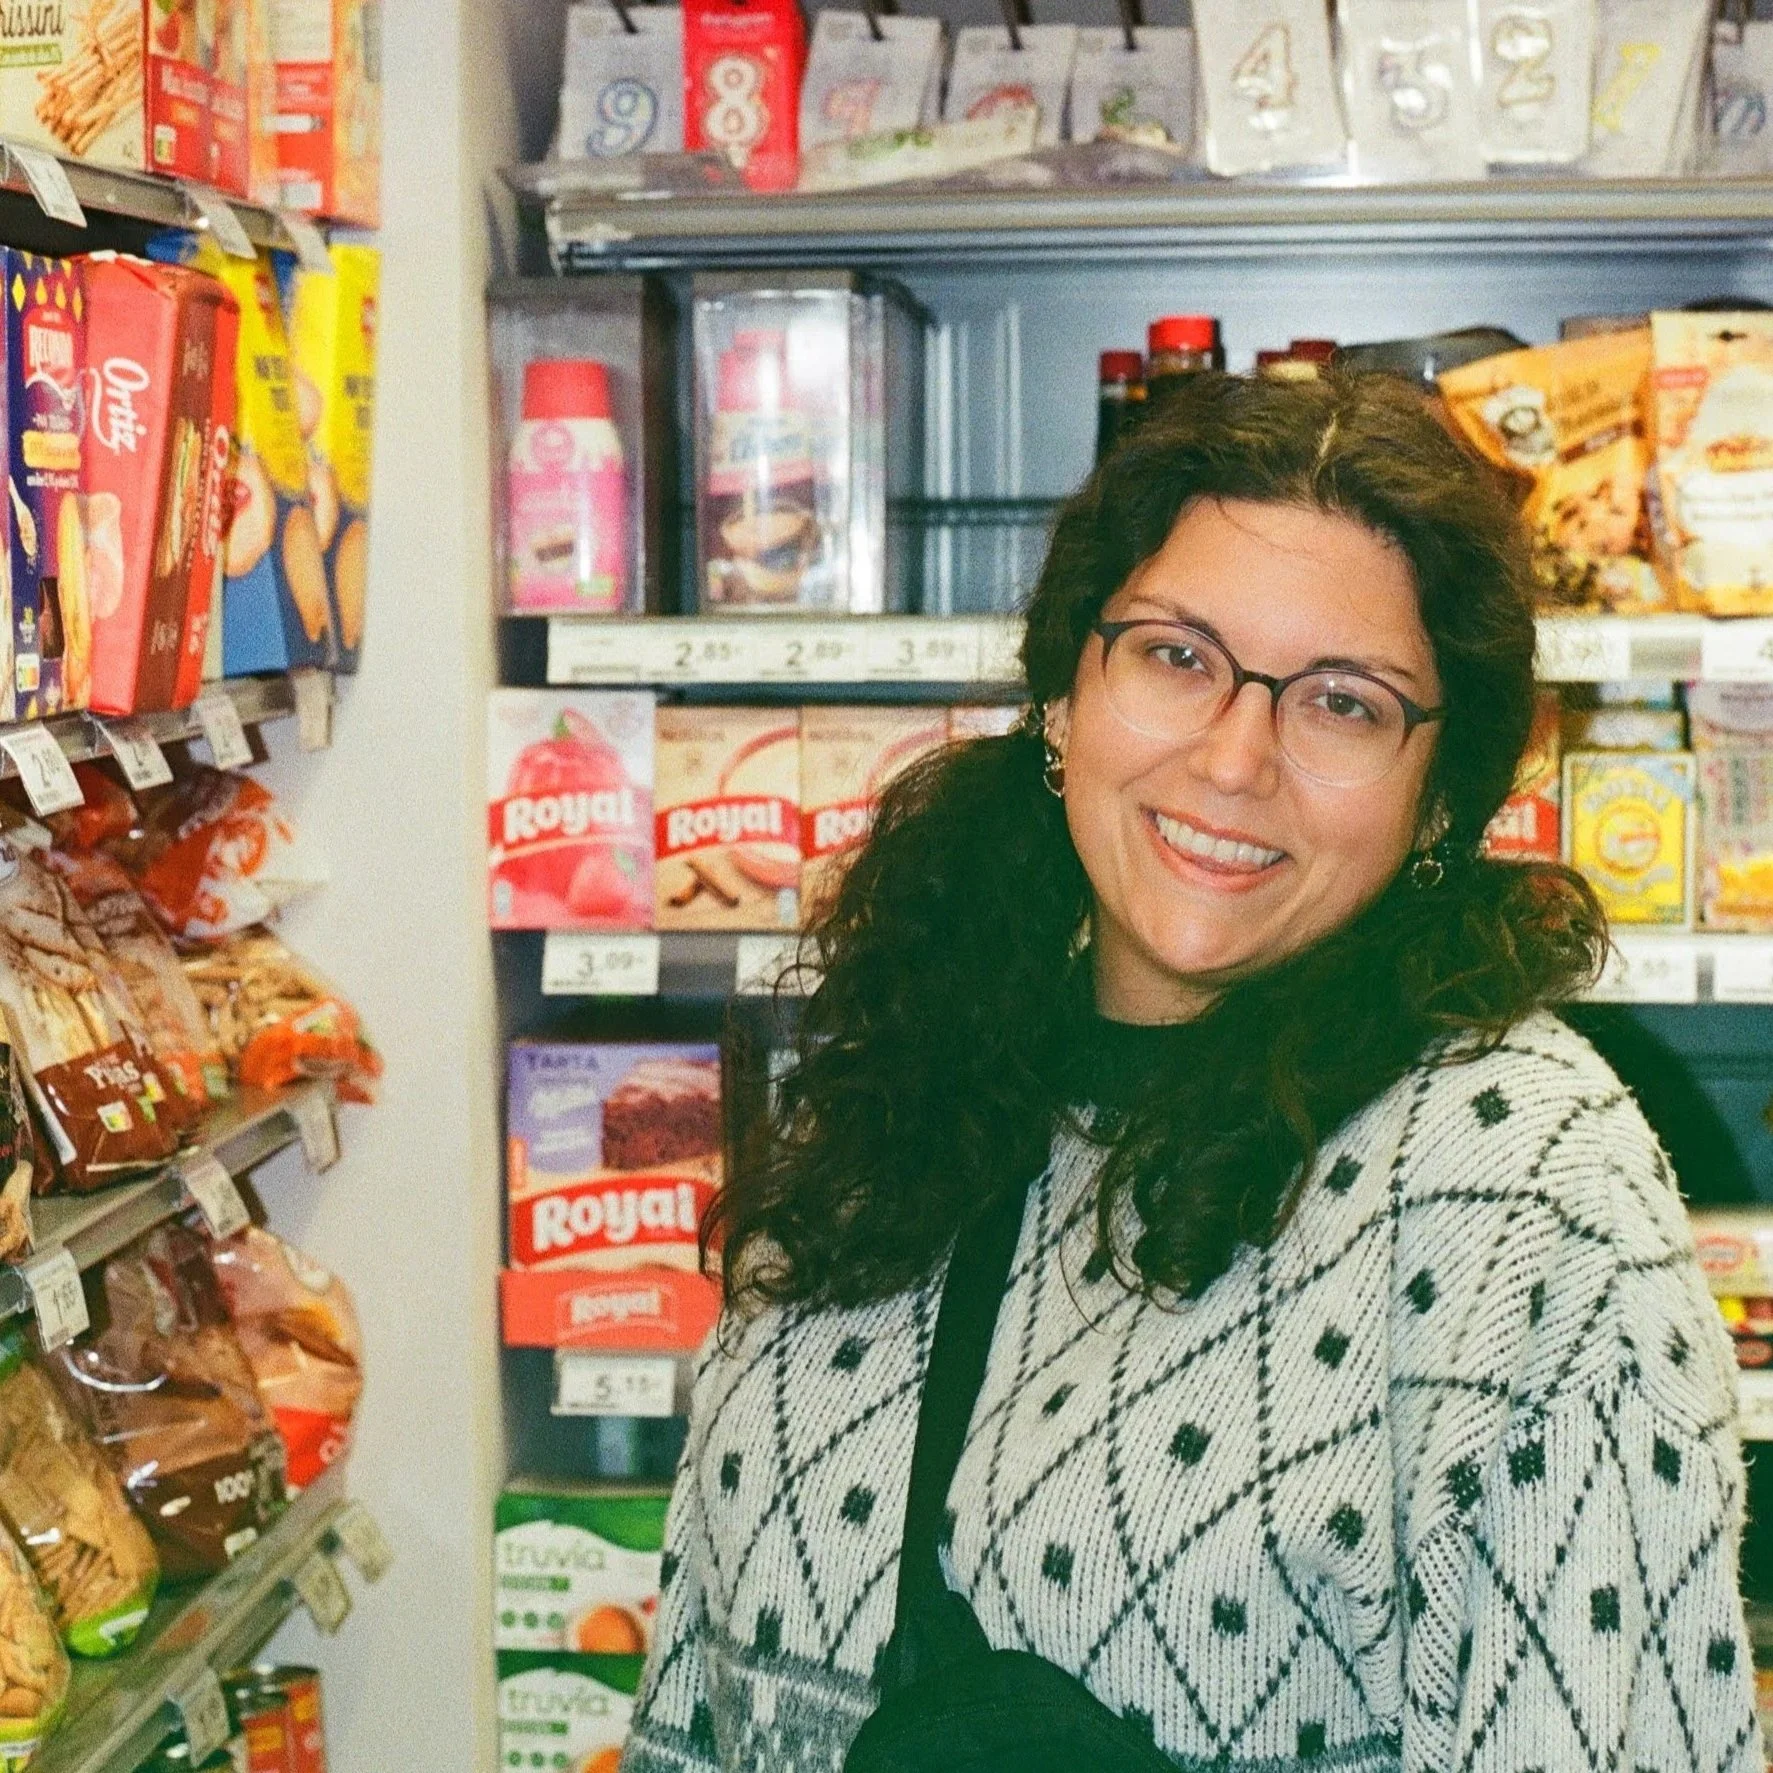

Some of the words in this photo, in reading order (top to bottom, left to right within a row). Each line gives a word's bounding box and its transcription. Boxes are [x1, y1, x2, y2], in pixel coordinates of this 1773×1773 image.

[585, 77, 660, 158] 9
[705, 55, 768, 152] 8
[90, 357, 151, 457] Ortiz
[503, 788, 634, 843] Royal
[666, 798, 783, 850] Royal
[532, 1182, 698, 1254] Royal
